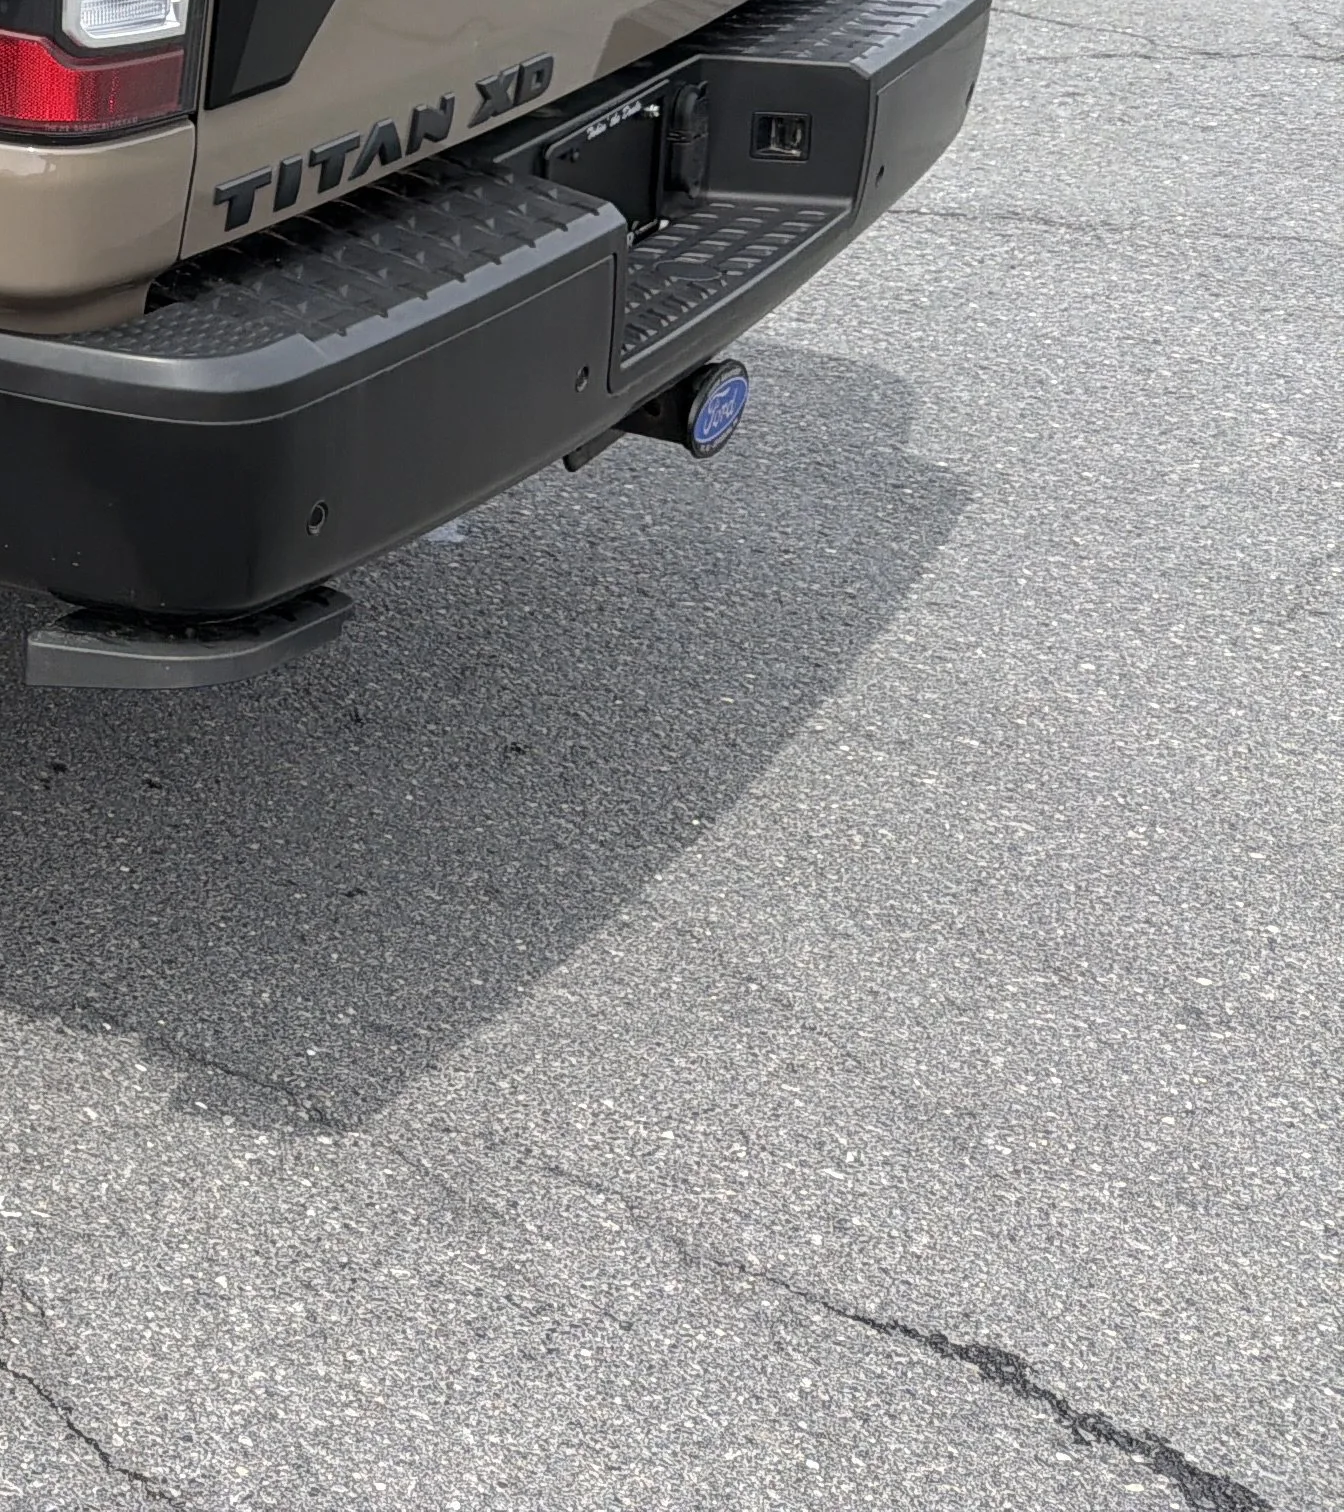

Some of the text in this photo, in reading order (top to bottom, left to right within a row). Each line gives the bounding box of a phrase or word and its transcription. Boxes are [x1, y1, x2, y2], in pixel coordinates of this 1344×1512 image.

[213, 52, 554, 232] TITAN XD
[701, 385, 740, 437] Ford
